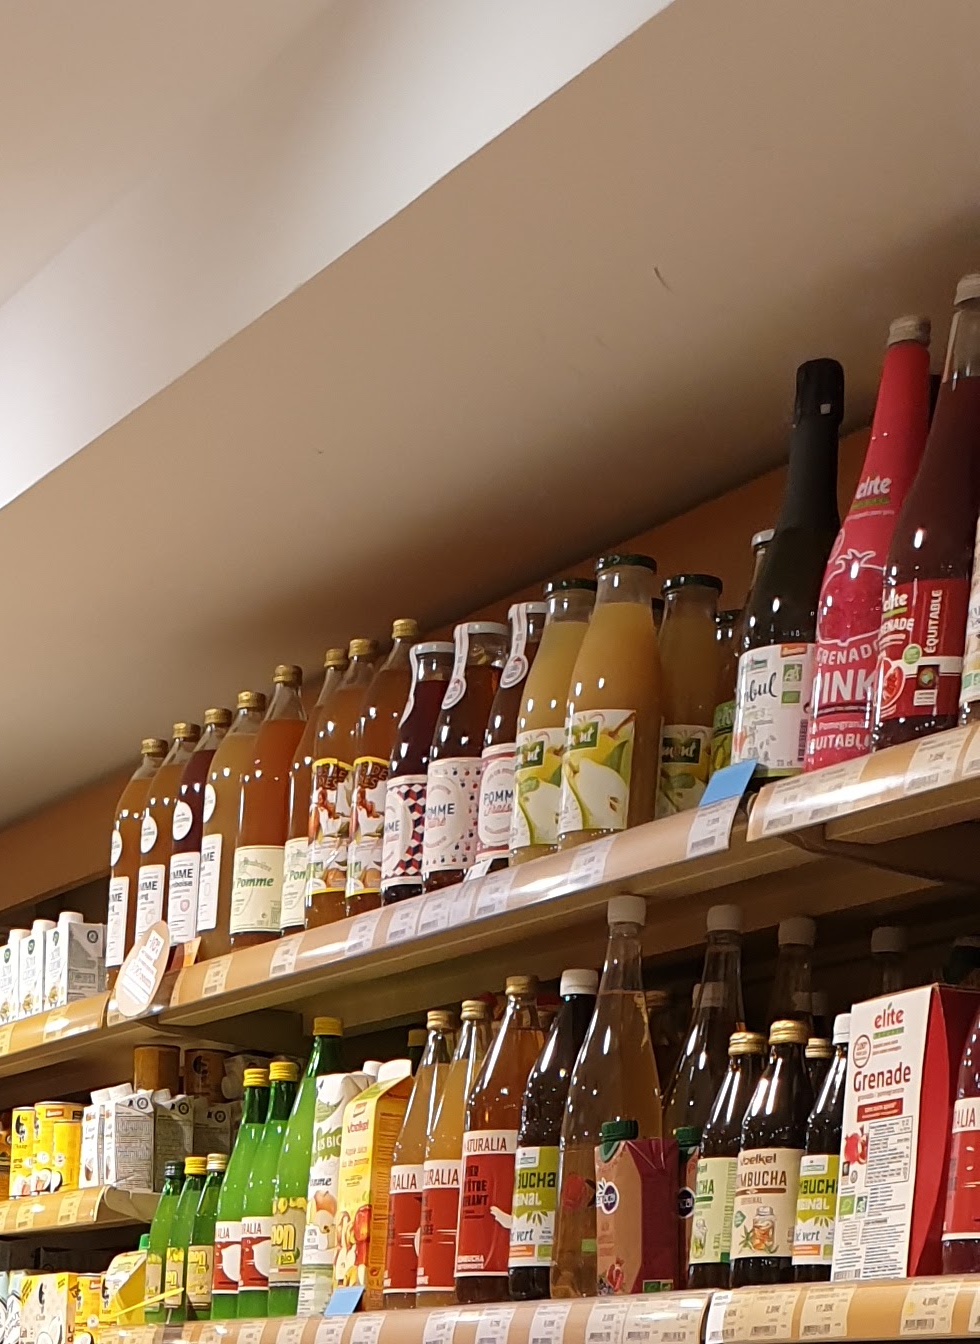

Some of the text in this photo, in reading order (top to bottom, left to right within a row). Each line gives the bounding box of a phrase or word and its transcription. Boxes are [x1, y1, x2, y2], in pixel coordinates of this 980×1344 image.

[881, 616, 915, 634] ENADE
[923, 589, 942, 654] ÉQUITABLE
[817, 644, 874, 668] RENAD
[814, 732, 870, 751] UITABL
[483, 788, 514, 805] POMM
[235, 875, 274, 888] Pomme
[288, 868, 306, 880] Pom
[874, 1003, 904, 1030] elite
[853, 1061, 912, 1093] Grenade
[464, 1136, 507, 1152] ATURALIA
[393, 1173, 417, 1190] RALIA
[740, 1170, 787, 1188] MBUCHA
[800, 1179, 838, 1195] BUCH
